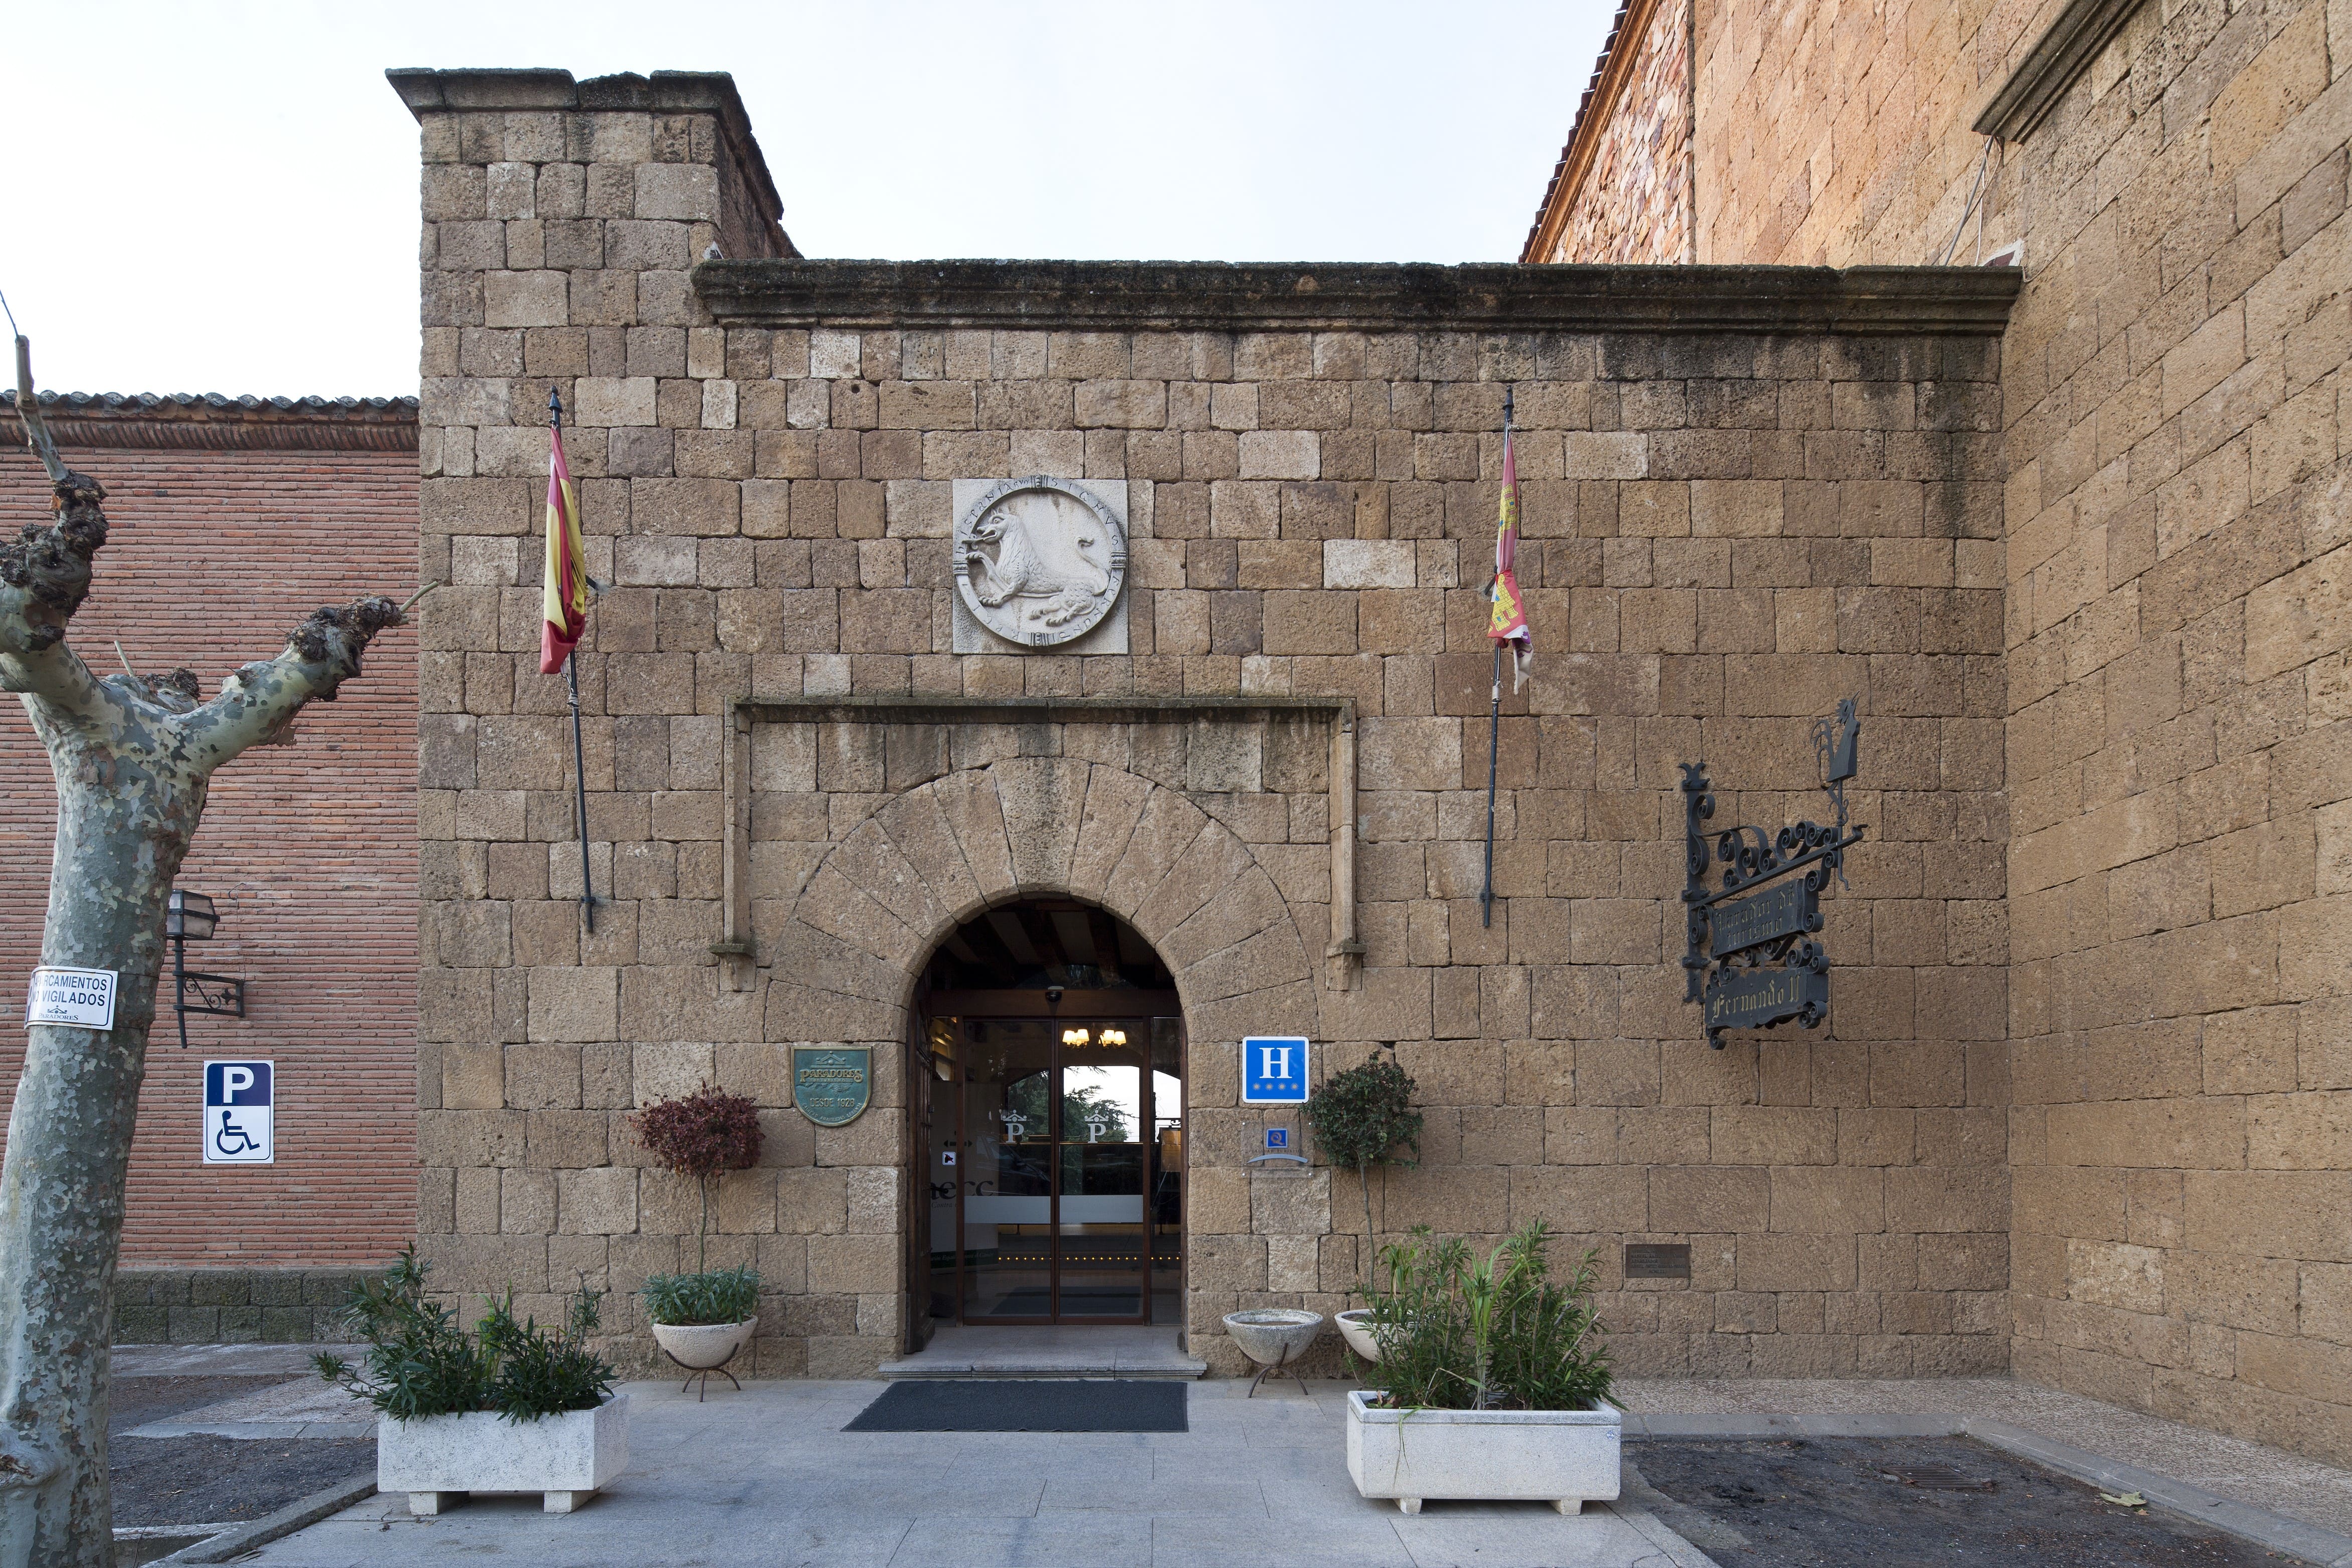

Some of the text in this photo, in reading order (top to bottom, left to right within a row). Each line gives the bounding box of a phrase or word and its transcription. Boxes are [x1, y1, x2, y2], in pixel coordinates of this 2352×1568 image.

[1716, 889, 1795, 935] Parador de
[1727, 916, 1782, 946] turismo
[43, 991, 105, 1006] VIGILADOS
[1712, 974, 1801, 1023] Fernando II
[38, 1013, 79, 1021] PARADORES
[1259, 1047, 1292, 1078] H
[224, 1066, 254, 1103] P
[800, 1069, 863, 1083] PARADORES
[810, 1098, 855, 1107] DESDE 1928
[1006, 1123, 1024, 1143] P
[1087, 1123, 1106, 1143] P
